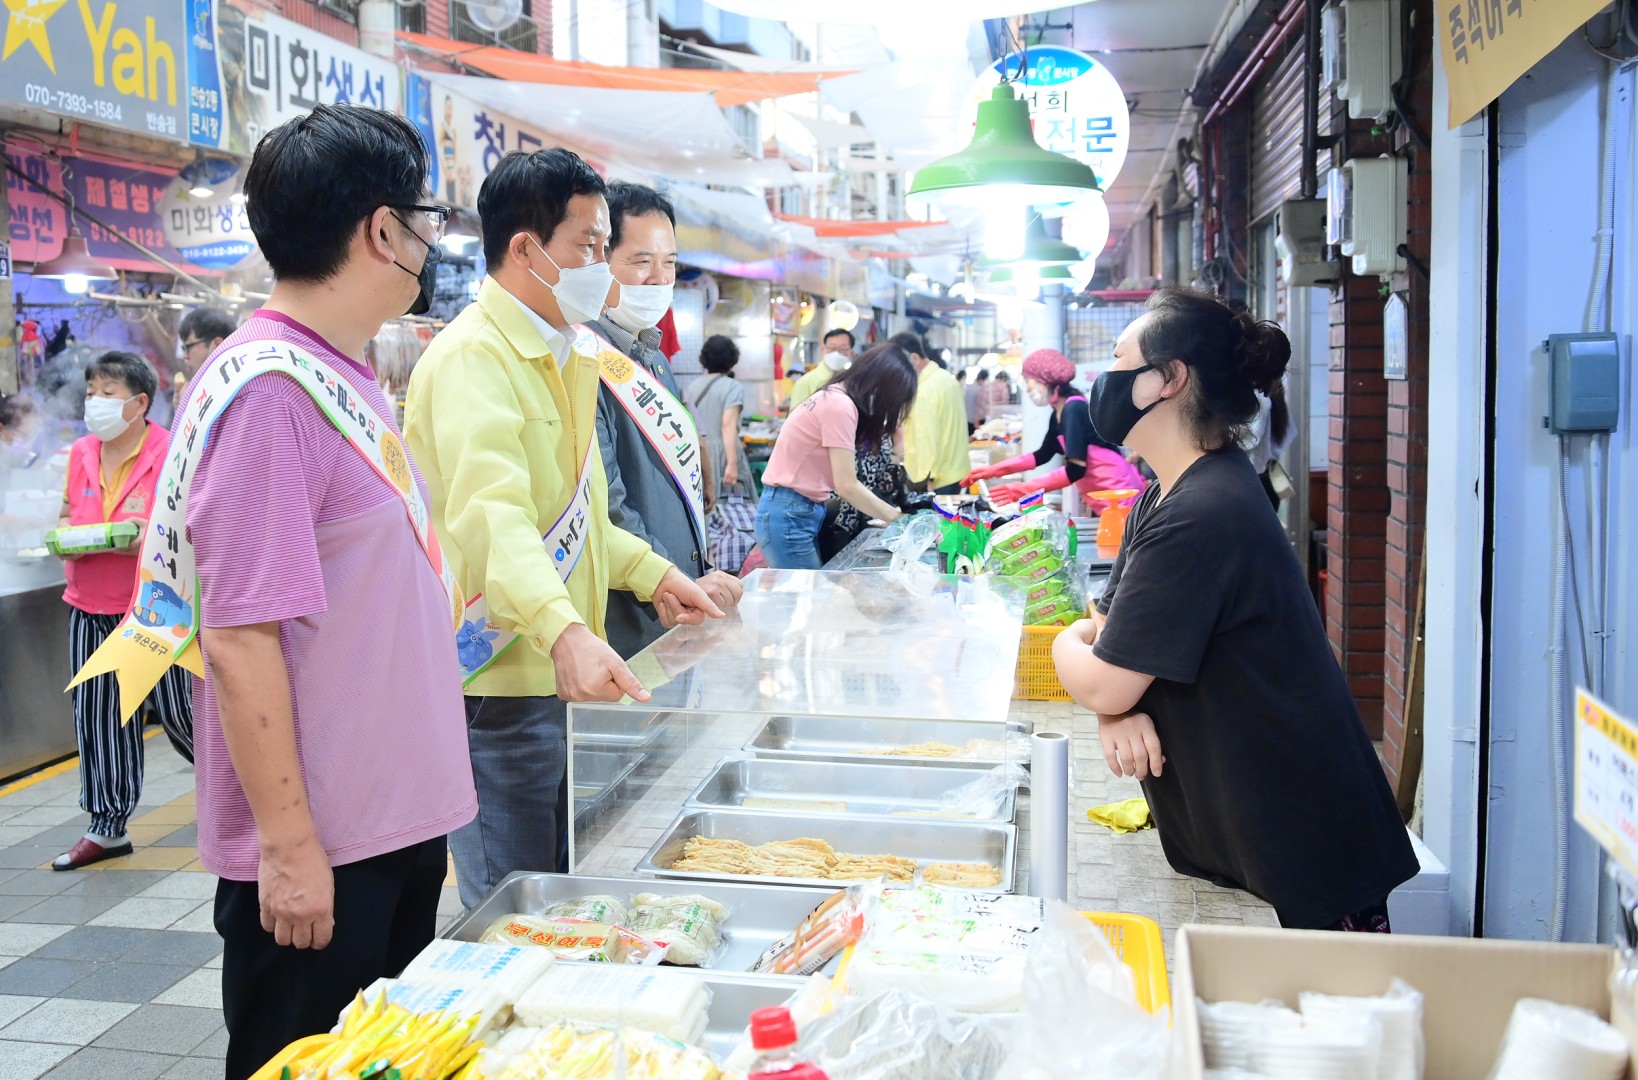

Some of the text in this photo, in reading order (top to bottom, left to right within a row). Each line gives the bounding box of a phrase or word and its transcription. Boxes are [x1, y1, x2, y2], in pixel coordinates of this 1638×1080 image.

[77, 0, 177, 107] Yah
[25, 83, 122, 121] 070-7393-1584
[146, 111, 177, 135] 반송점
[632, 379, 695, 467] 살맛나는
[133, 632, 169, 657] 해운대구
